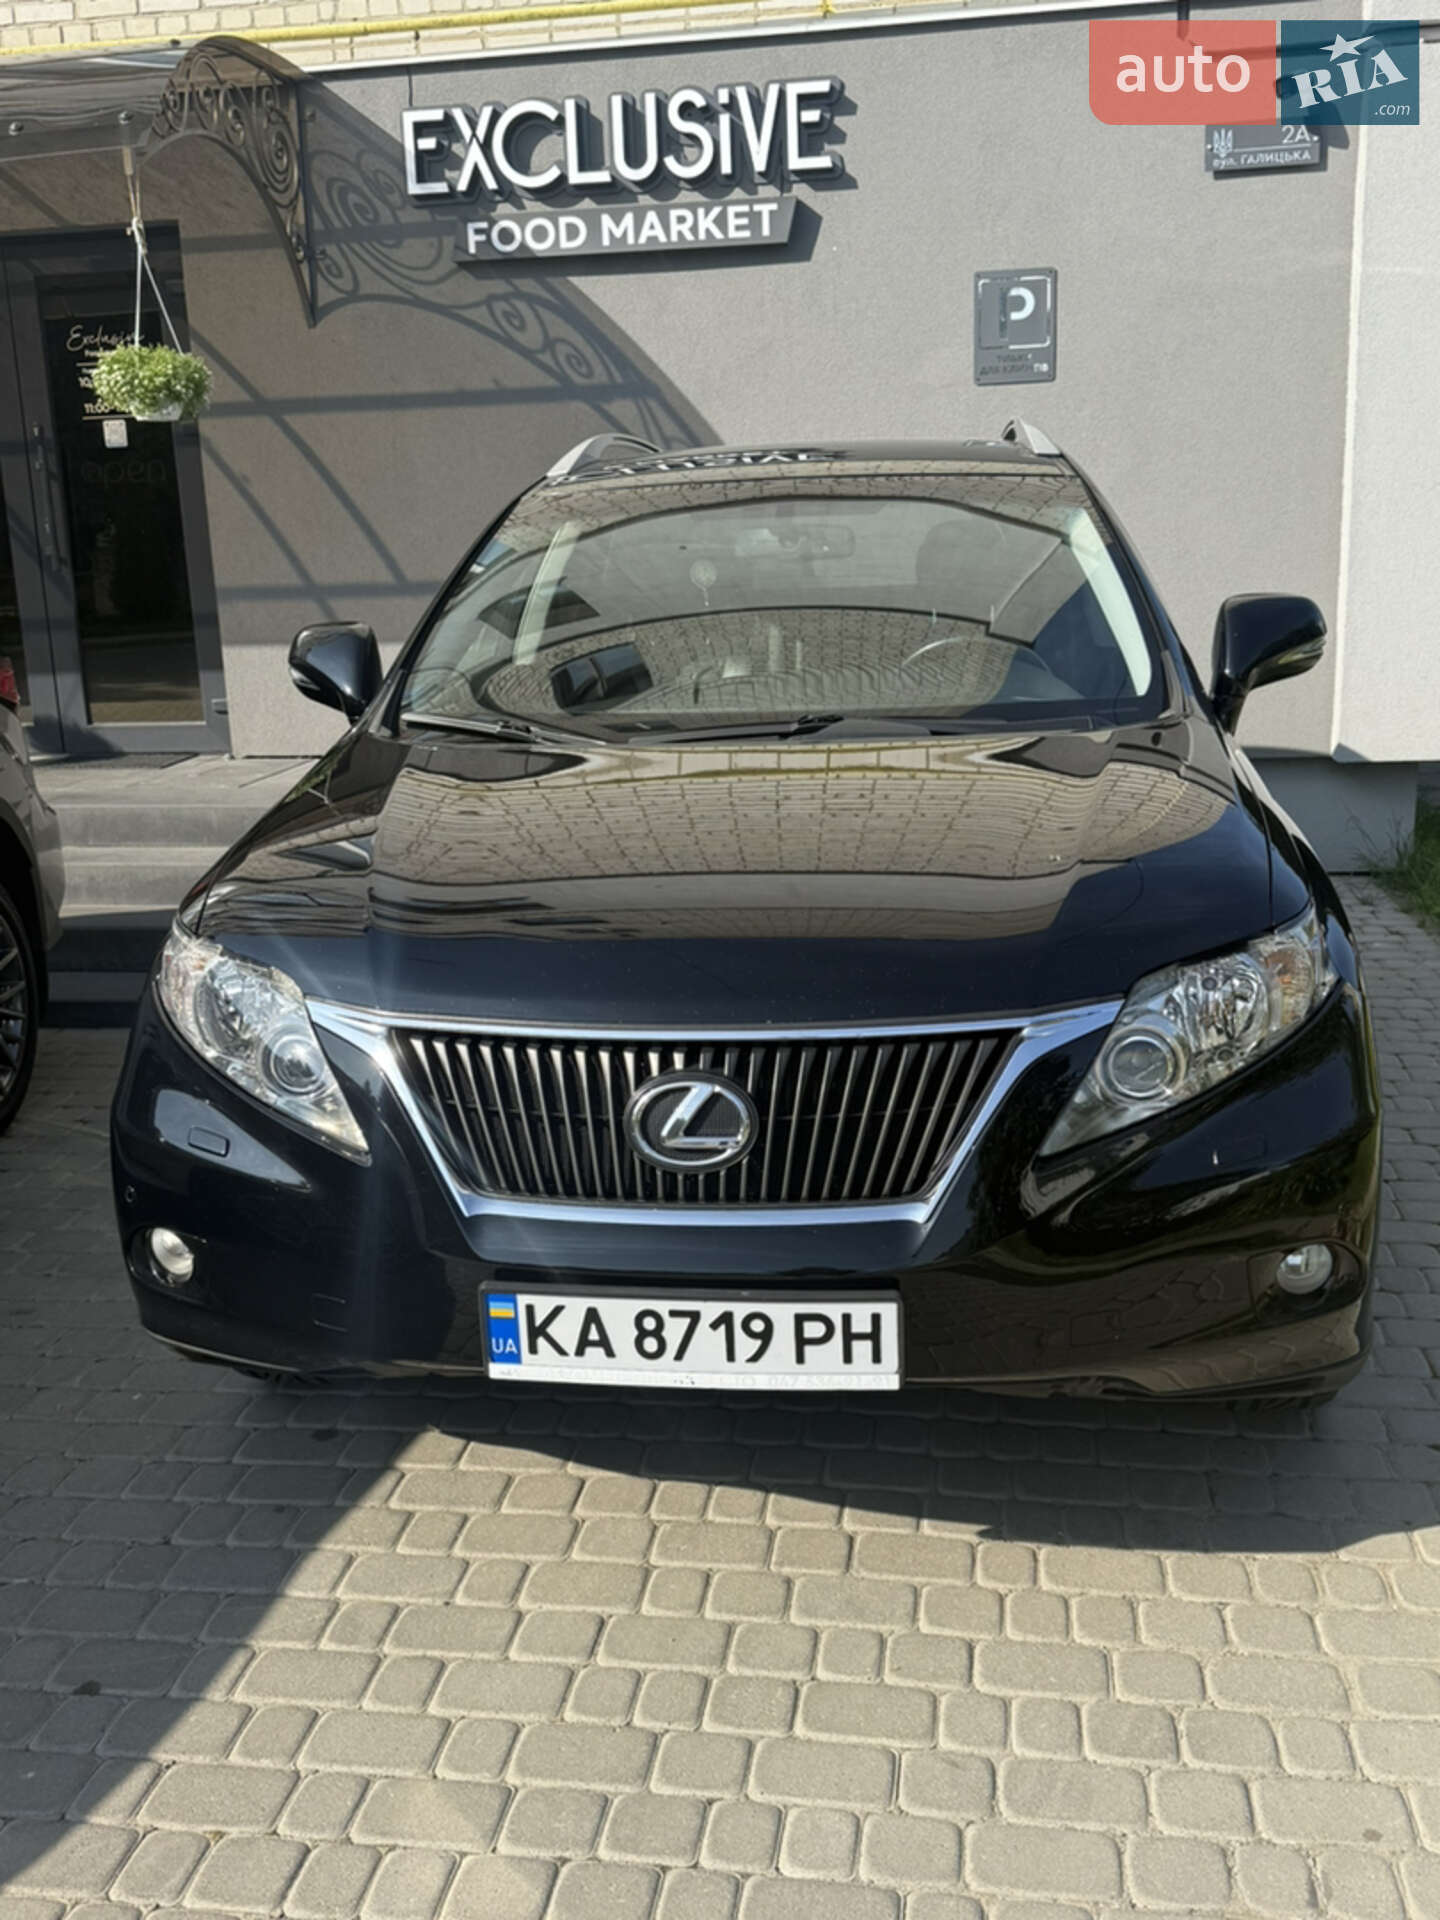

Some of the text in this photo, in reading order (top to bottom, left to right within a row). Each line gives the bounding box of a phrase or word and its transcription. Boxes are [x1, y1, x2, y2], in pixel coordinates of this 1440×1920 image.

[1240, 149, 1311, 165] ГАЛИЦЬКА
[466, 203, 778, 254] FOOD MARKET
[491, 1338, 518, 1354] UA
[525, 1303, 883, 1364] KA 8719 PH
